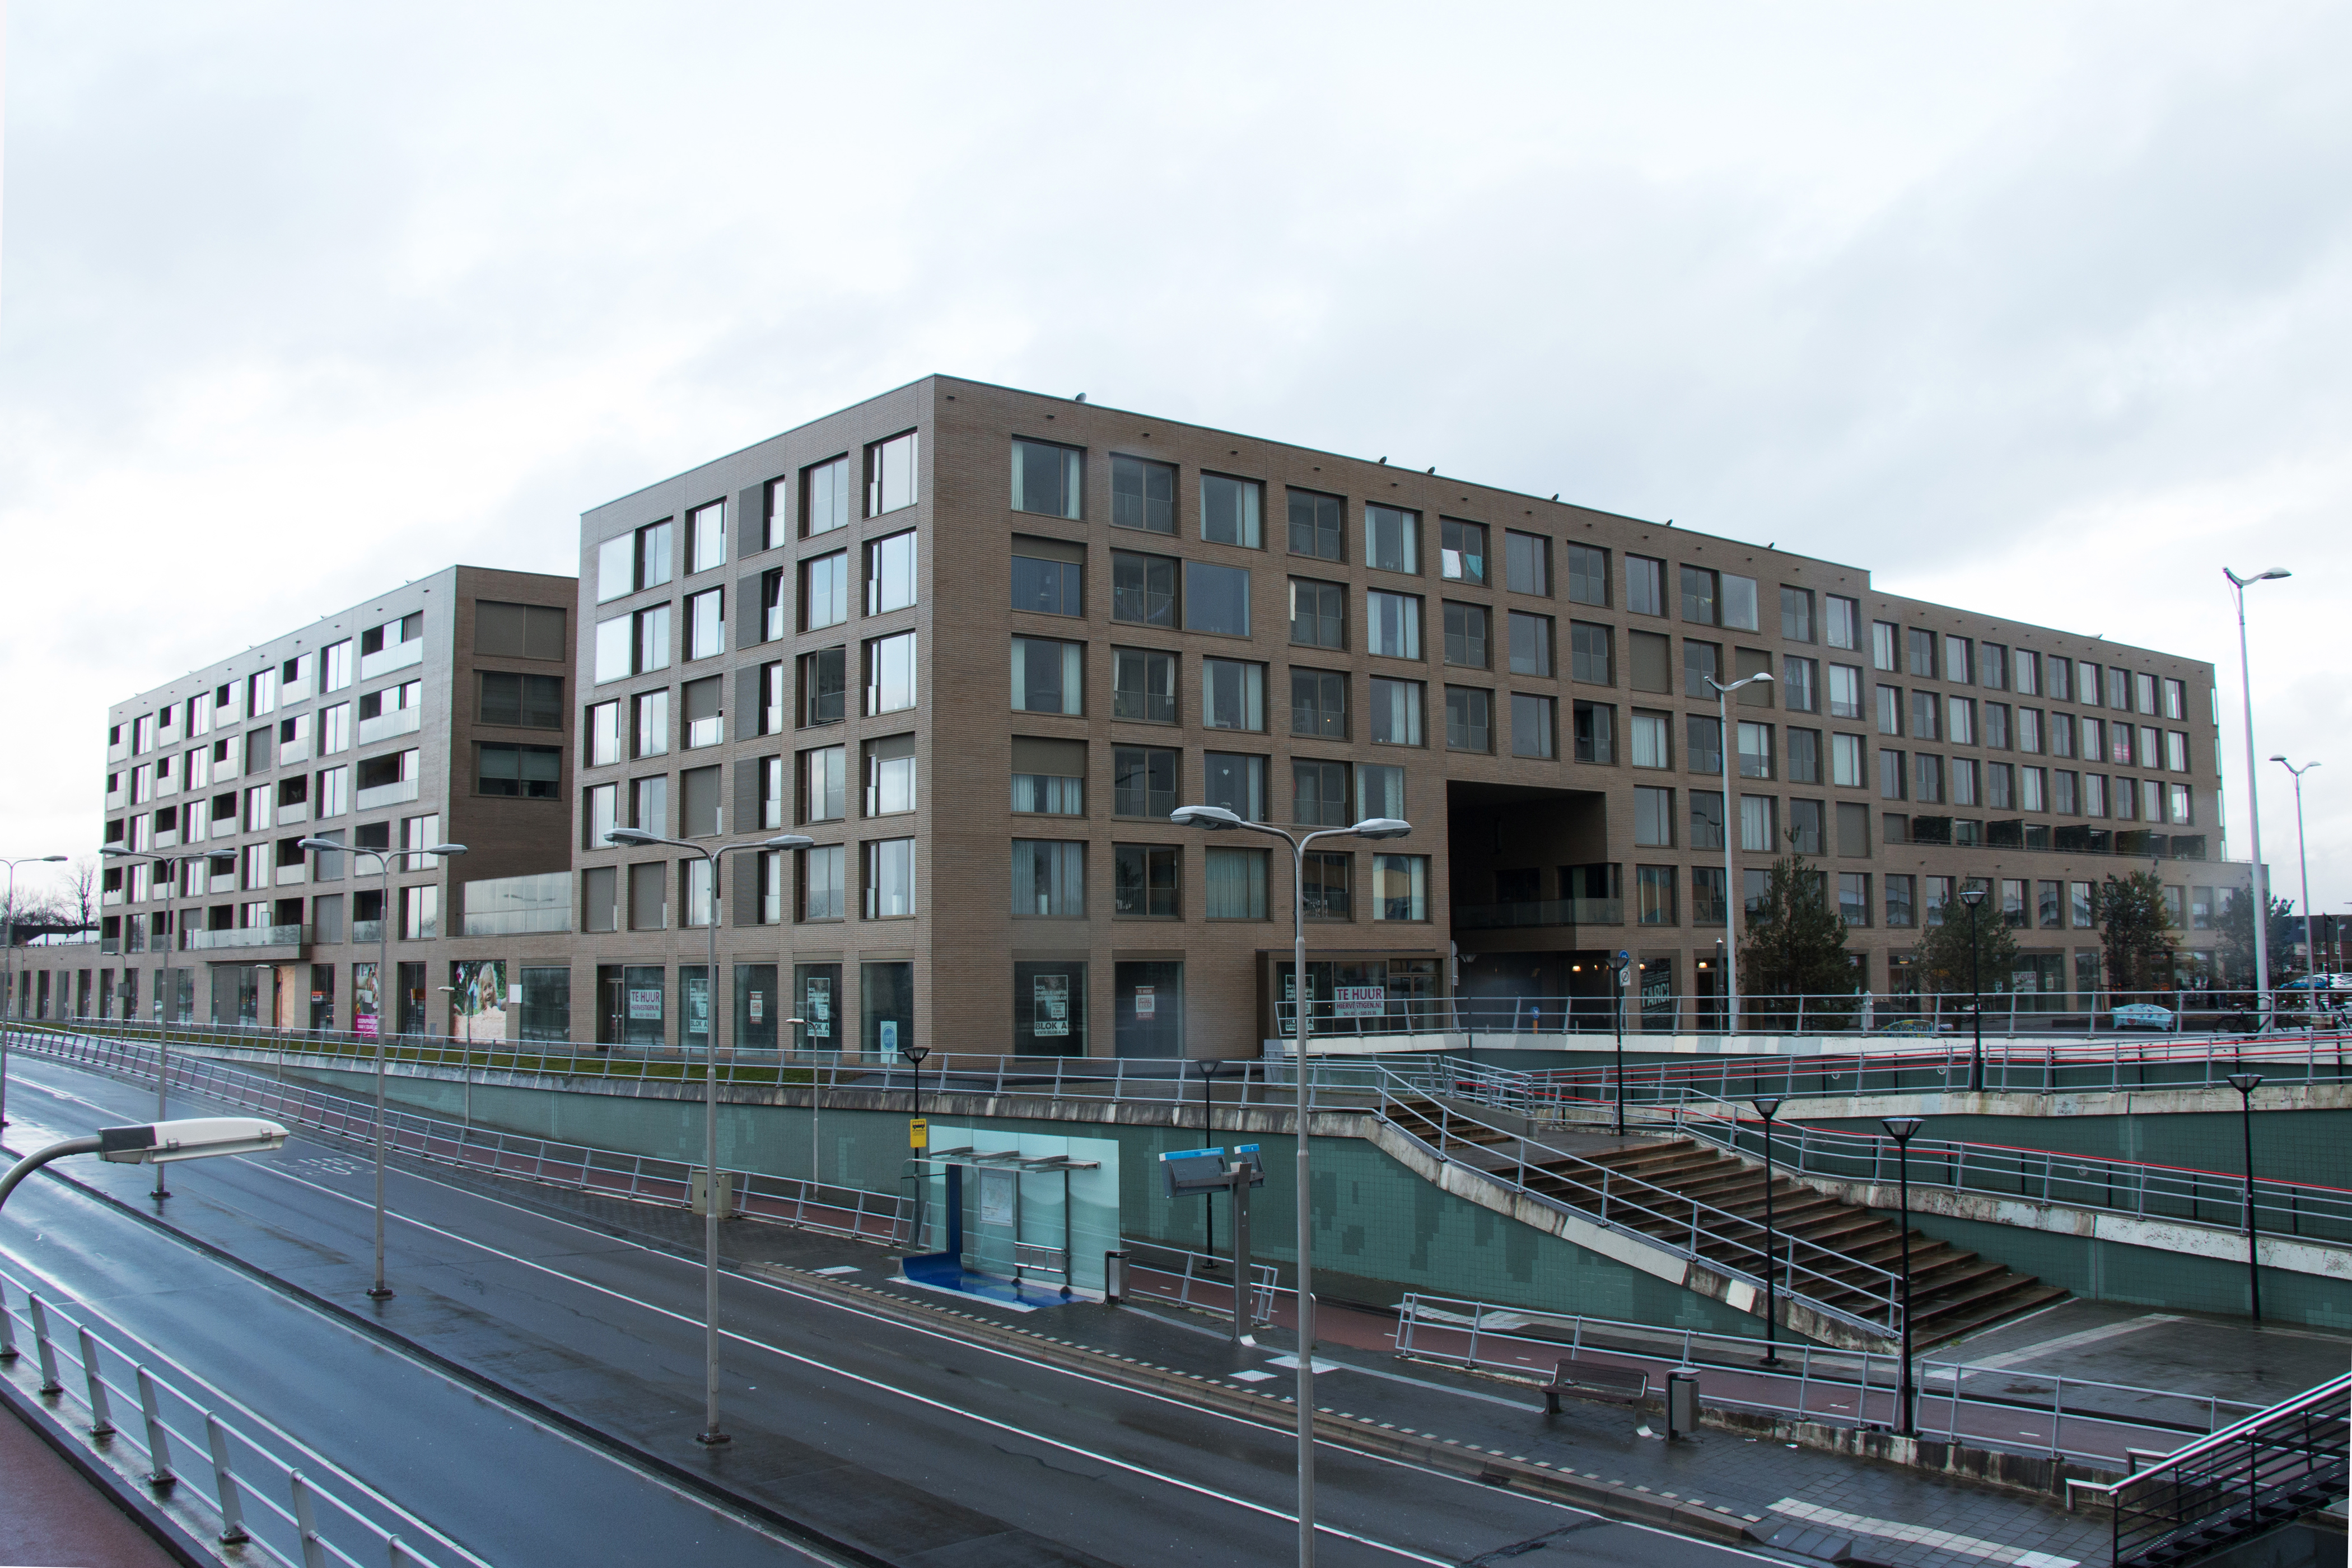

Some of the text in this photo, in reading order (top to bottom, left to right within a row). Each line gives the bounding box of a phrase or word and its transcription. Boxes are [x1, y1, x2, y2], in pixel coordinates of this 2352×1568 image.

[632, 991, 660, 1002] TE HUUR
[1337, 988, 1382, 1000] TE HUUR
[1641, 982, 1670, 1007] FARCI
